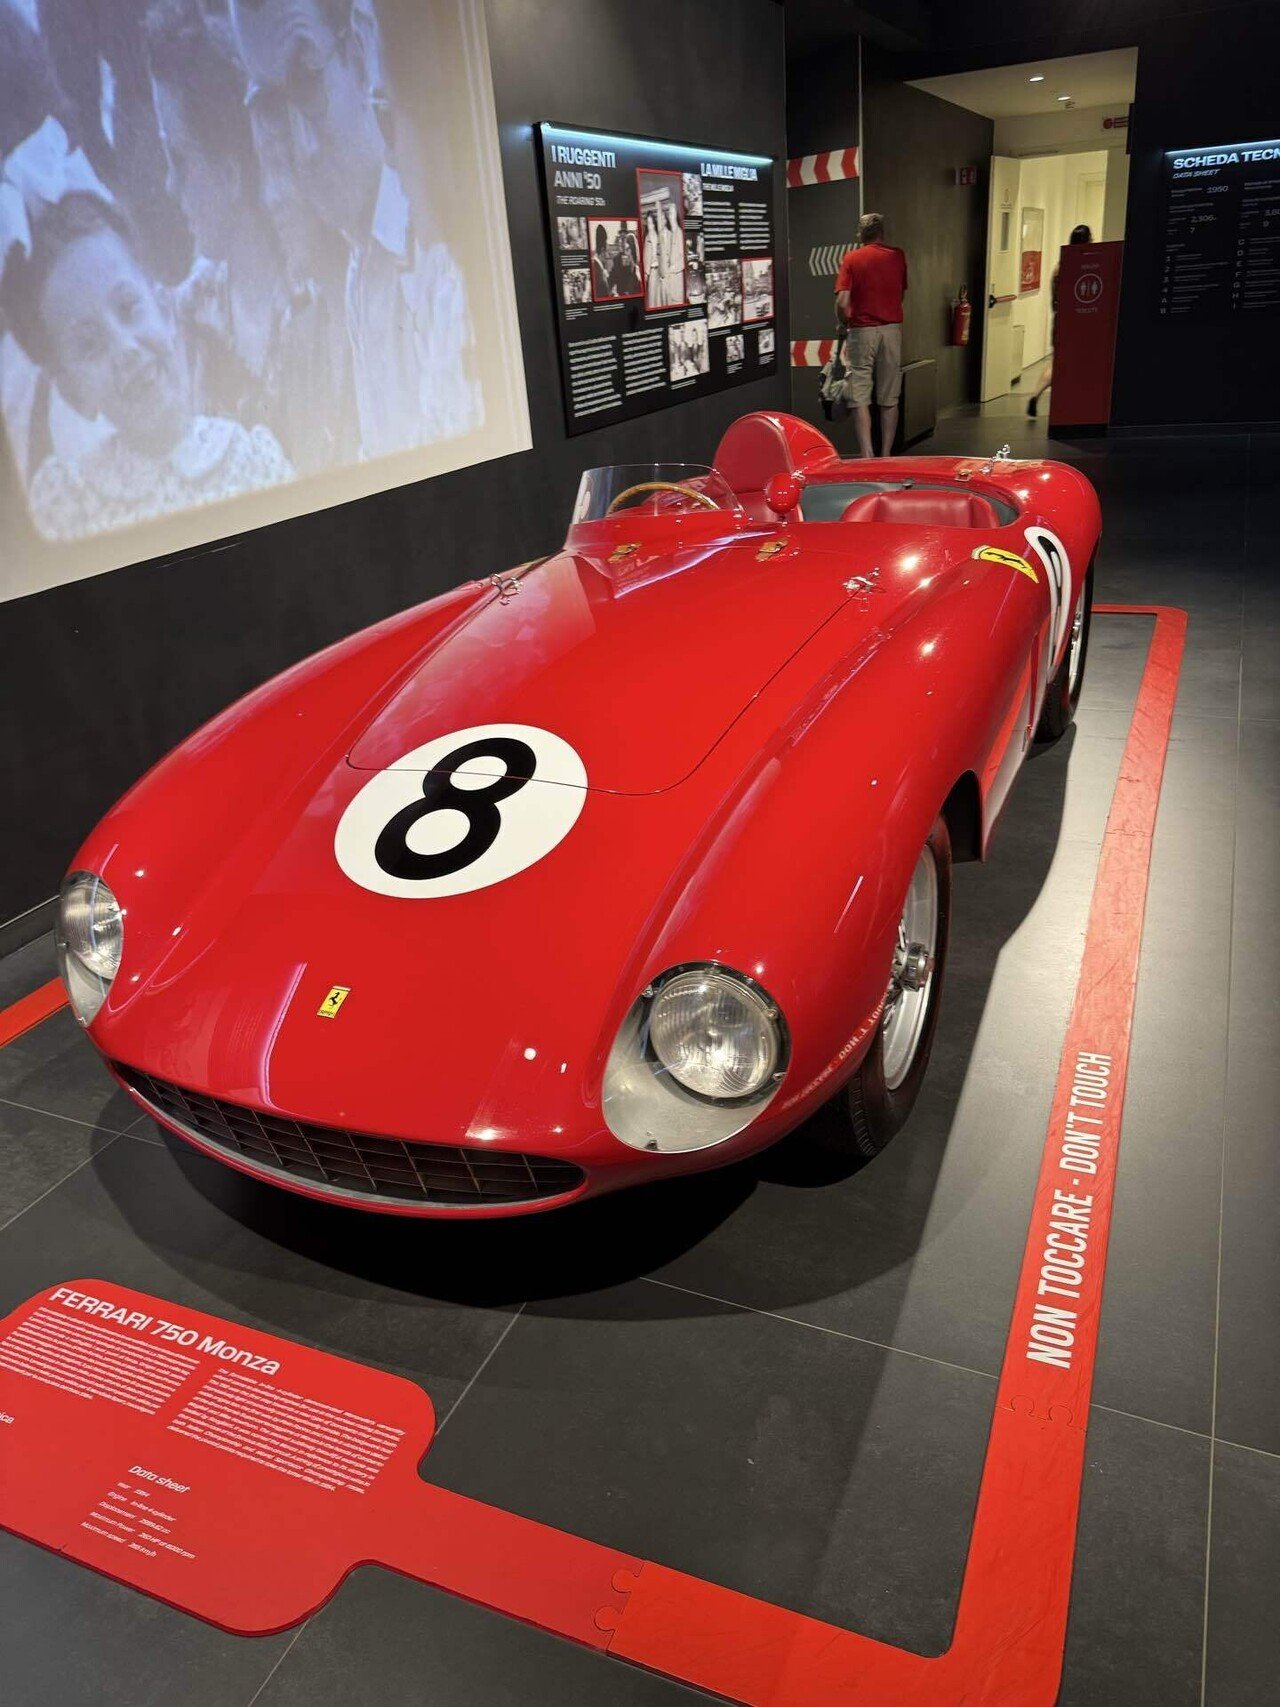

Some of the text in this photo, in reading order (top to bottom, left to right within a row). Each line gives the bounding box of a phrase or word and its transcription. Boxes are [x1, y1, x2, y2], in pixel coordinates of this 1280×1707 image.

[551, 145, 616, 168] I RUGGENTI
[554, 170, 583, 189] ANNI
[1173, 148, 1280, 169] SCHEDA TECN
[374, 737, 537, 881] 8
[1069, 1051, 1112, 1127] TOUCH
[1059, 1111, 1101, 1175] DON'T
[1037, 1188, 1093, 1299] TOCCARE
[49, 1287, 282, 1376] FERRARI 750 Monza
[1025, 1306, 1077, 1369] NON
[127, 1465, 191, 1494] Data sheet
